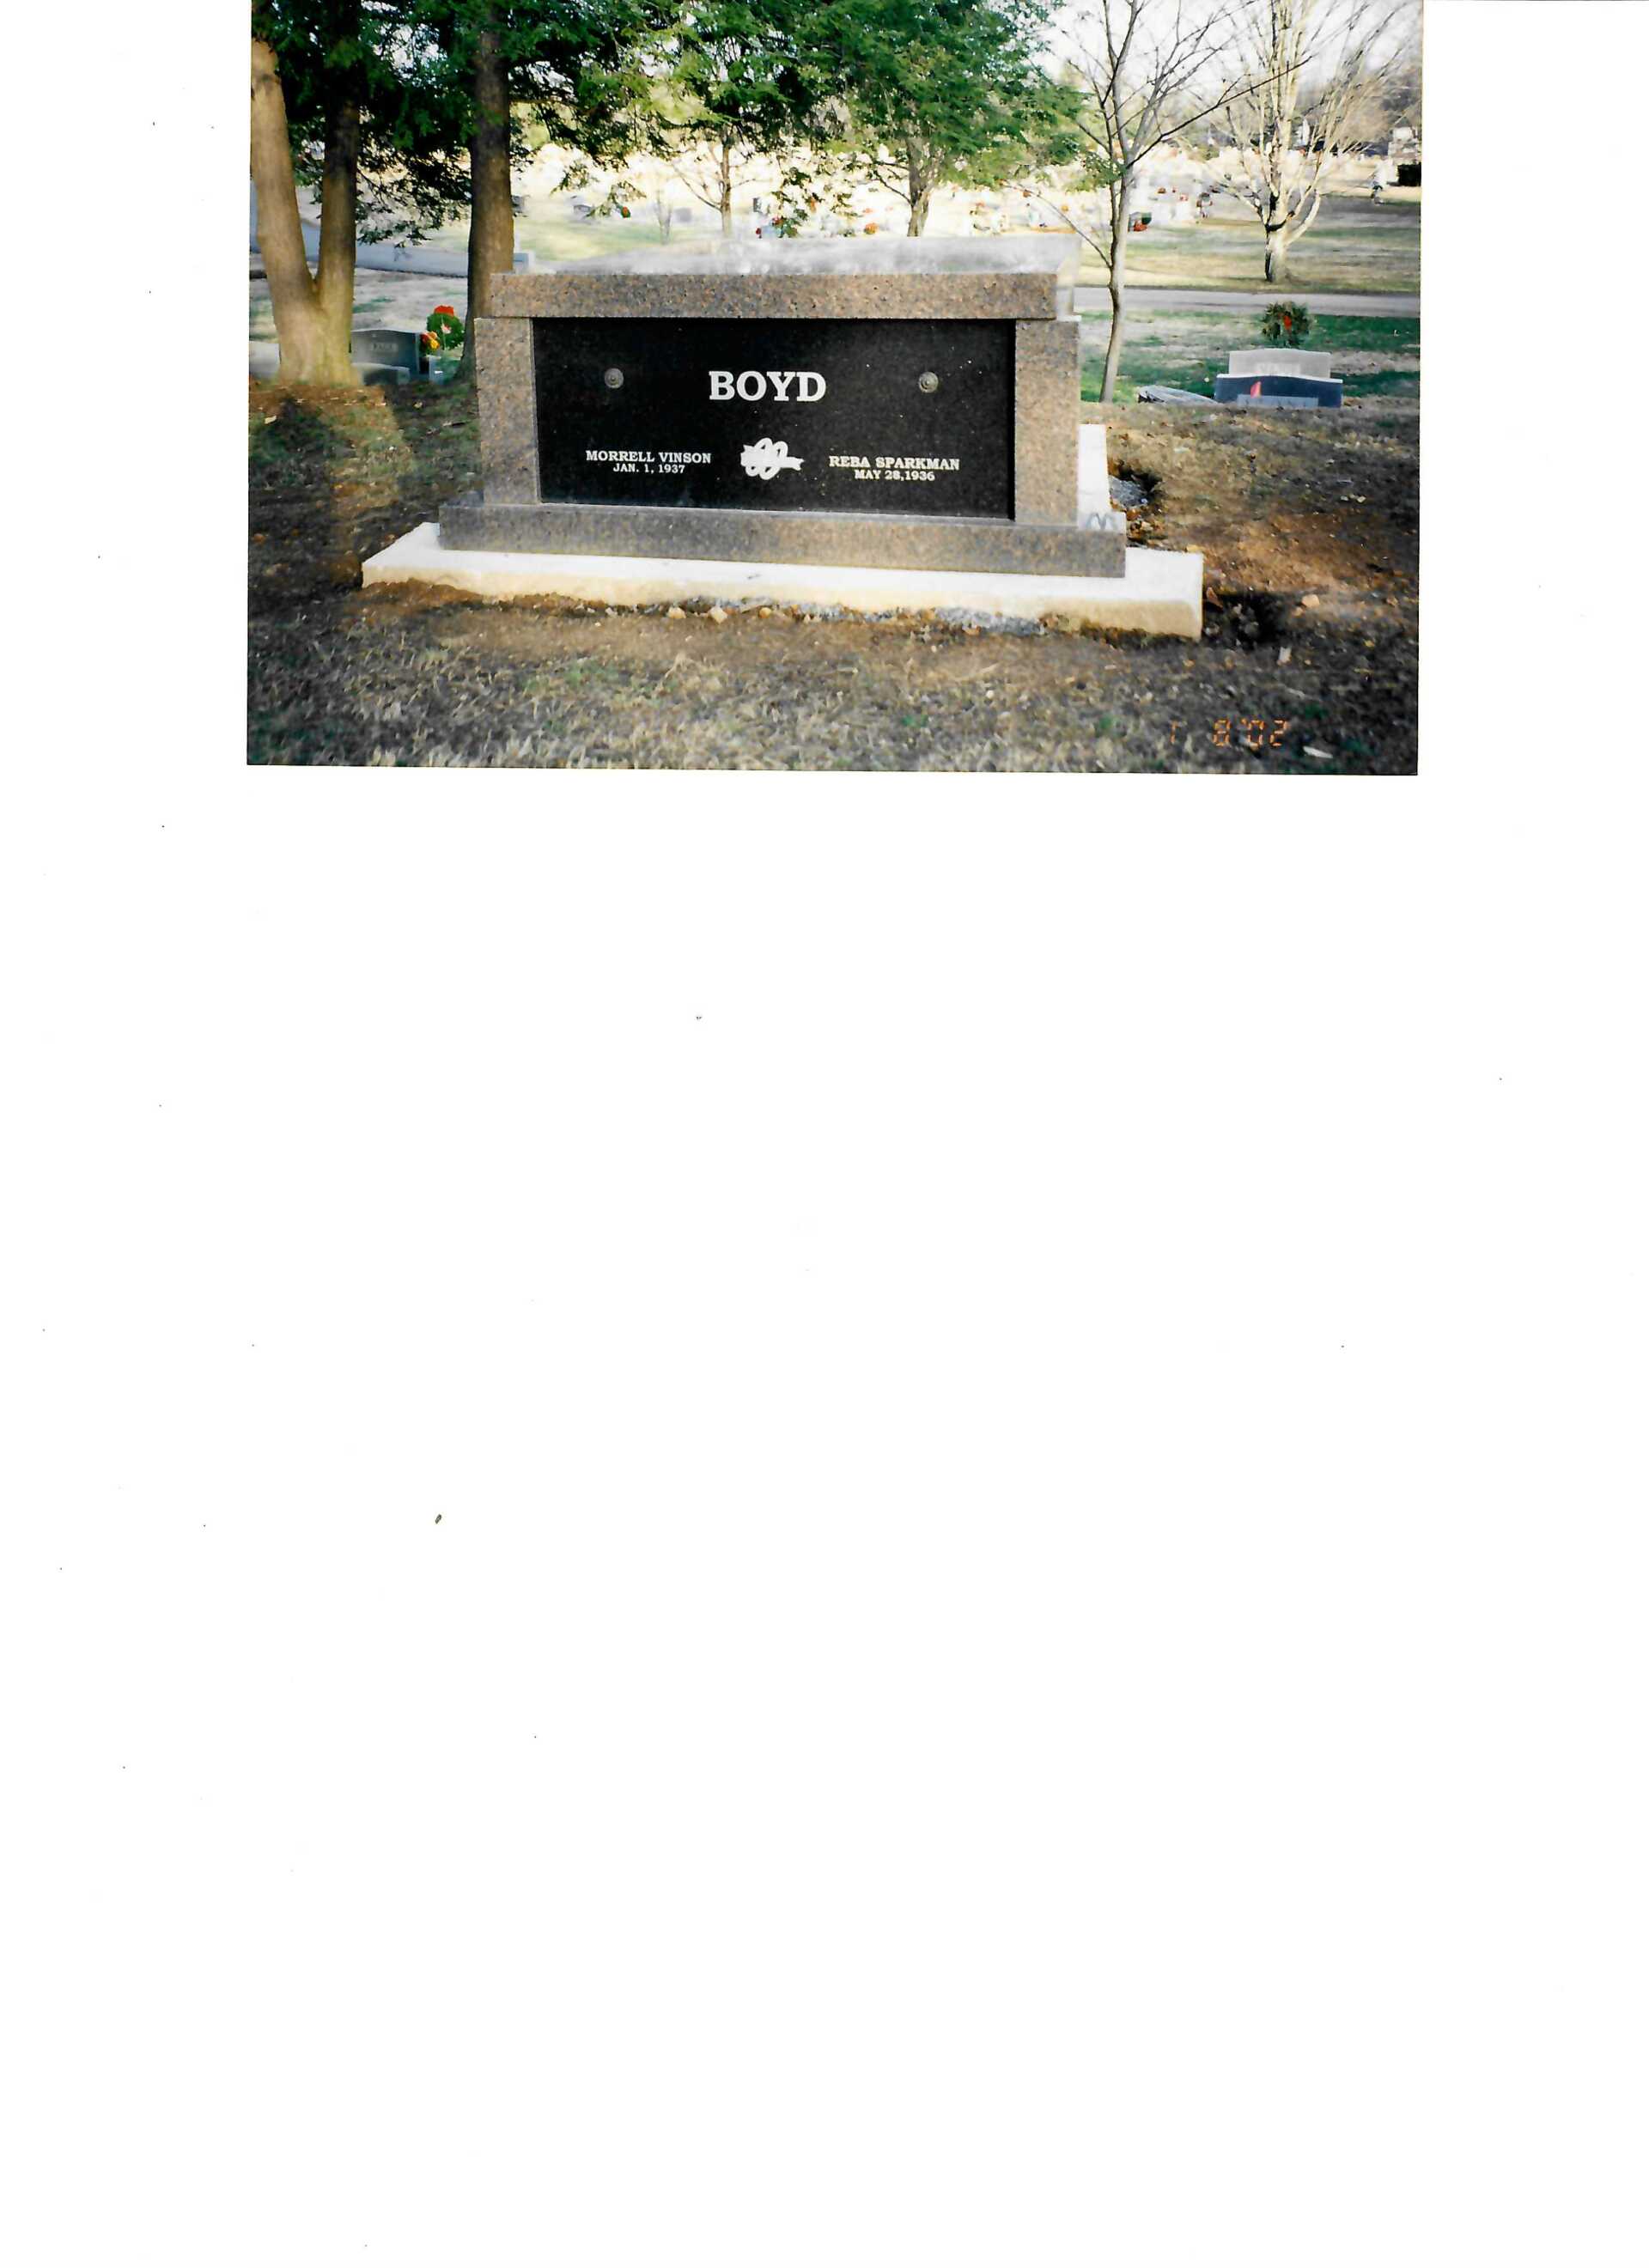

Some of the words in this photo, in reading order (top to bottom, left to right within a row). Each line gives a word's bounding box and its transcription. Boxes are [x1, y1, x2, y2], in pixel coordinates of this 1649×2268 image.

[709, 370, 827, 402] BOYD
[585, 450, 655, 463] MORRELL
[658, 452, 712, 464] VINSON
[828, 455, 871, 468] REBA
[875, 457, 960, 471] SPARKMAN
[612, 463, 640, 473] JAN.
[644, 464, 654, 474] 1,
[658, 464, 685, 474] 1937
[854, 469, 882, 480] MAY
